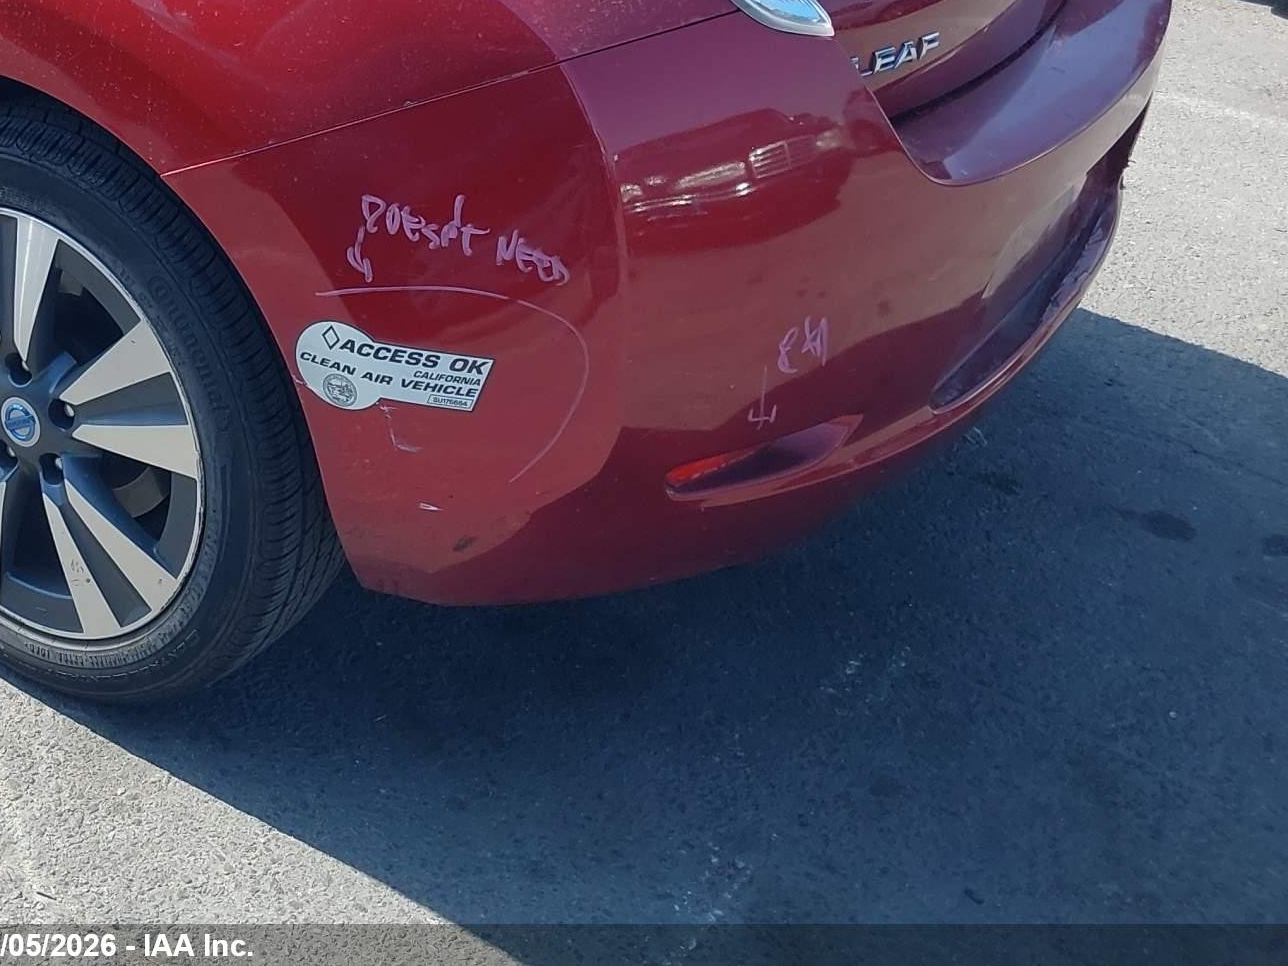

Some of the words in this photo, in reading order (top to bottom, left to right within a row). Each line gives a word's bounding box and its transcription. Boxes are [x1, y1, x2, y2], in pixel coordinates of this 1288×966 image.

[300, 351, 357, 375] CLEAN
[361, 371, 393, 385] AIR
[401, 378, 479, 397] VEHICLE
[339, 339, 441, 369] ACCESS
[449, 357, 489, 375] OK
[413, 370, 481, 386] CALIFORNIA
